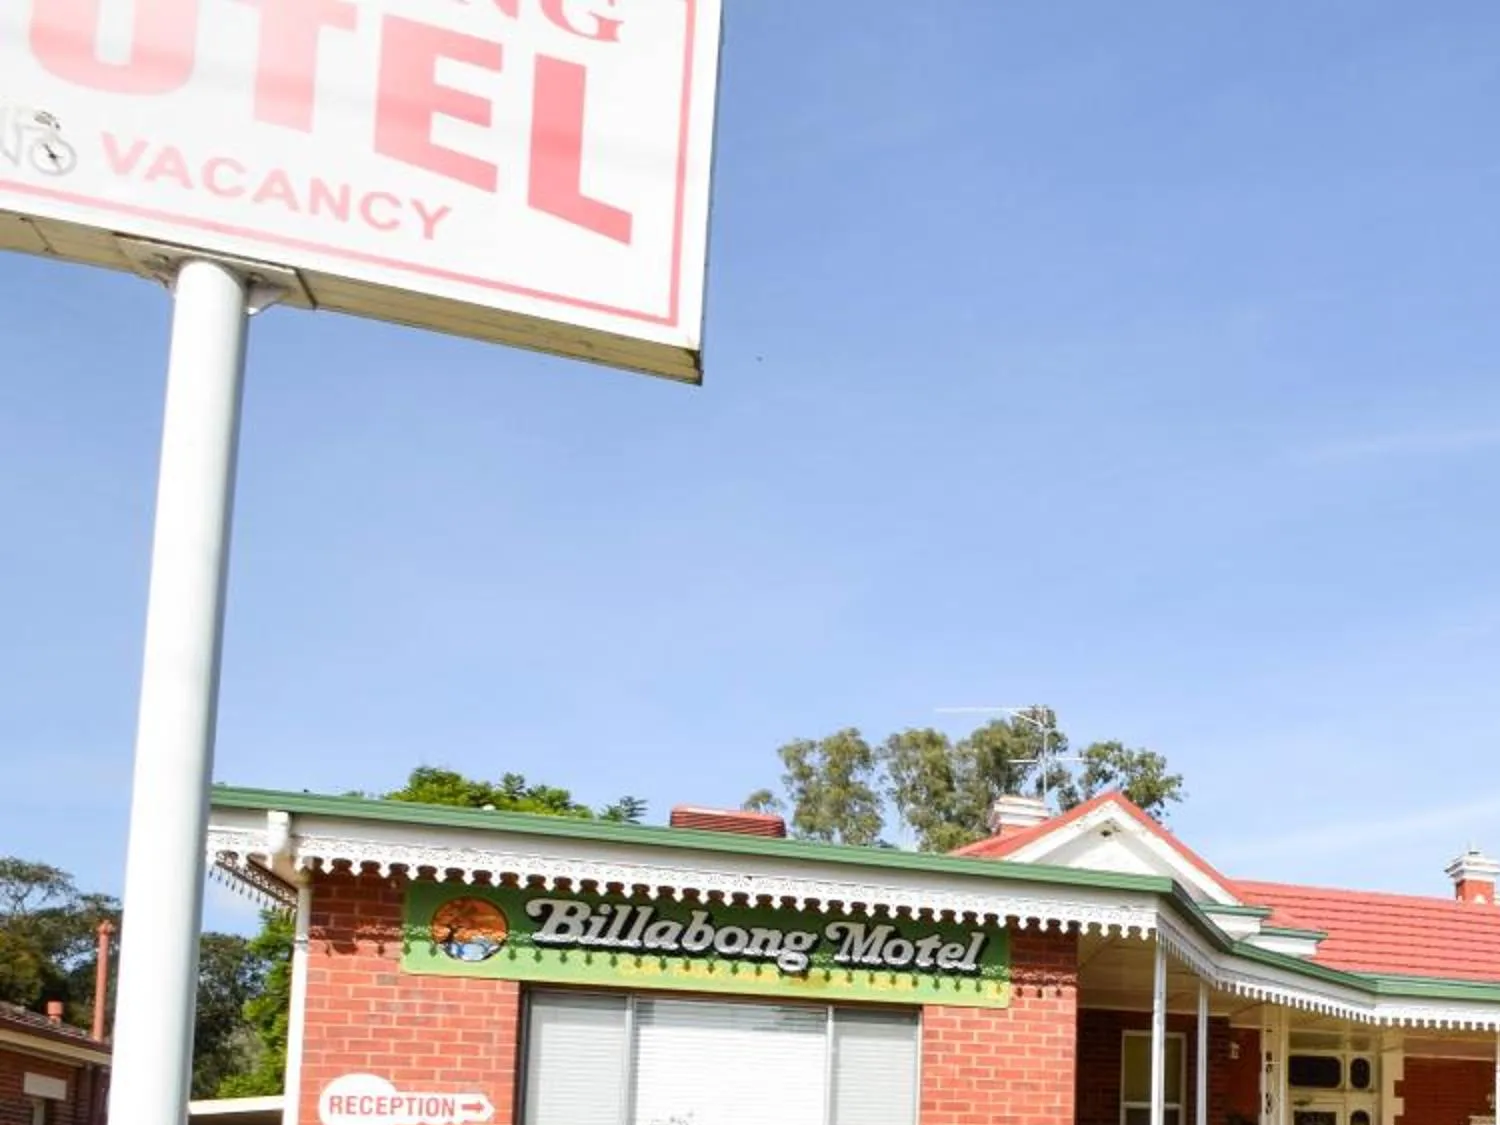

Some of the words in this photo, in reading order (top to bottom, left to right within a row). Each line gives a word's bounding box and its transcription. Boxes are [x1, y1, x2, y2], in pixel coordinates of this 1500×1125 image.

[101, 131, 452, 241] VACANCY
[525, 898, 820, 973] Billabong
[824, 922, 986, 971] Motel
[329, 1095, 456, 1117] RECEPTION
